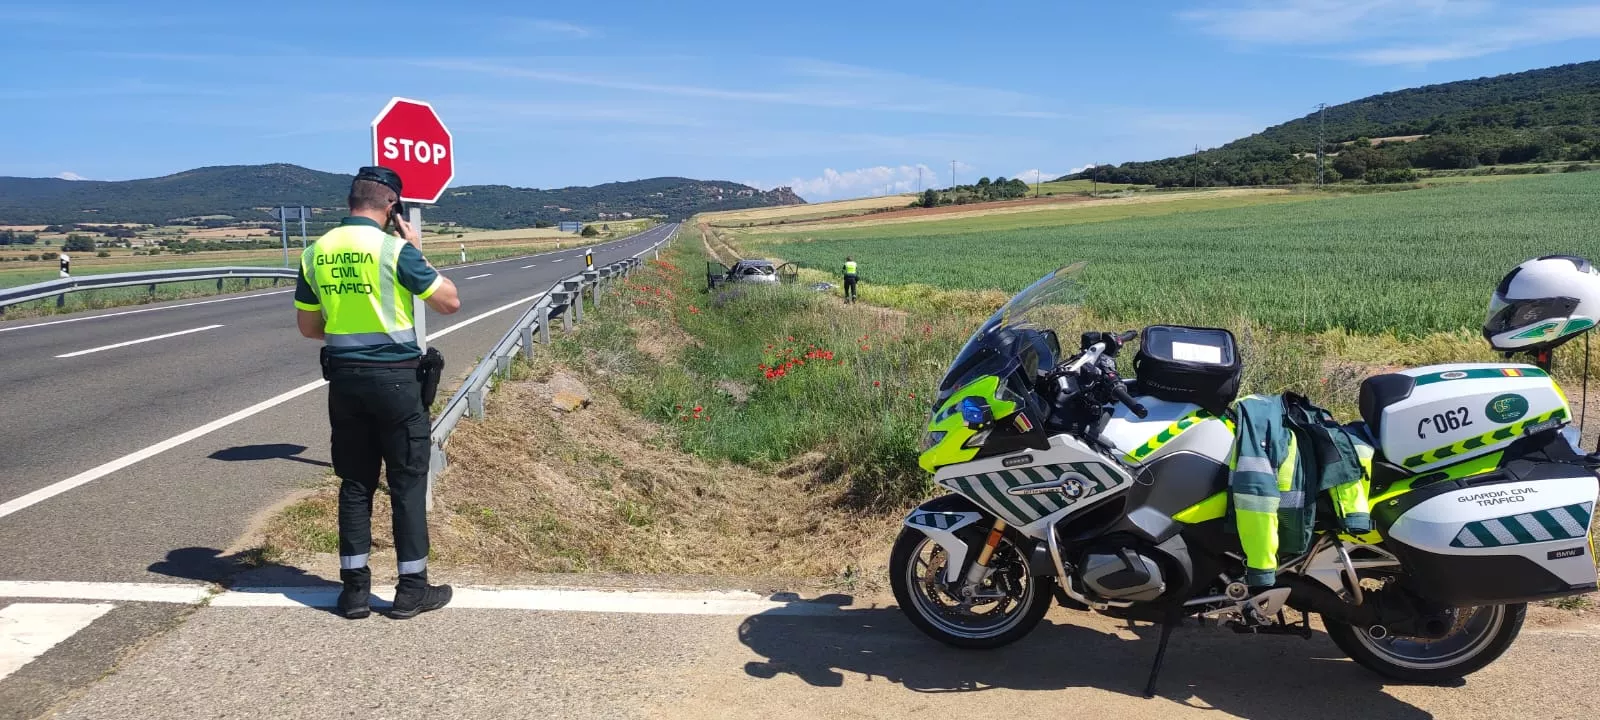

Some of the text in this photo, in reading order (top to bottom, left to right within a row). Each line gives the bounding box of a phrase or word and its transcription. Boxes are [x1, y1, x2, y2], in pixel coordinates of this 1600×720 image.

[383, 136, 447, 165] STOP
[316, 252, 373, 265] GUARDIA
[331, 266, 359, 278] CIVIL
[1432, 406, 1473, 434] 062
[1458, 487, 1538, 503] GUARDIA CIVIL
[1555, 549, 1577, 558] BMW
